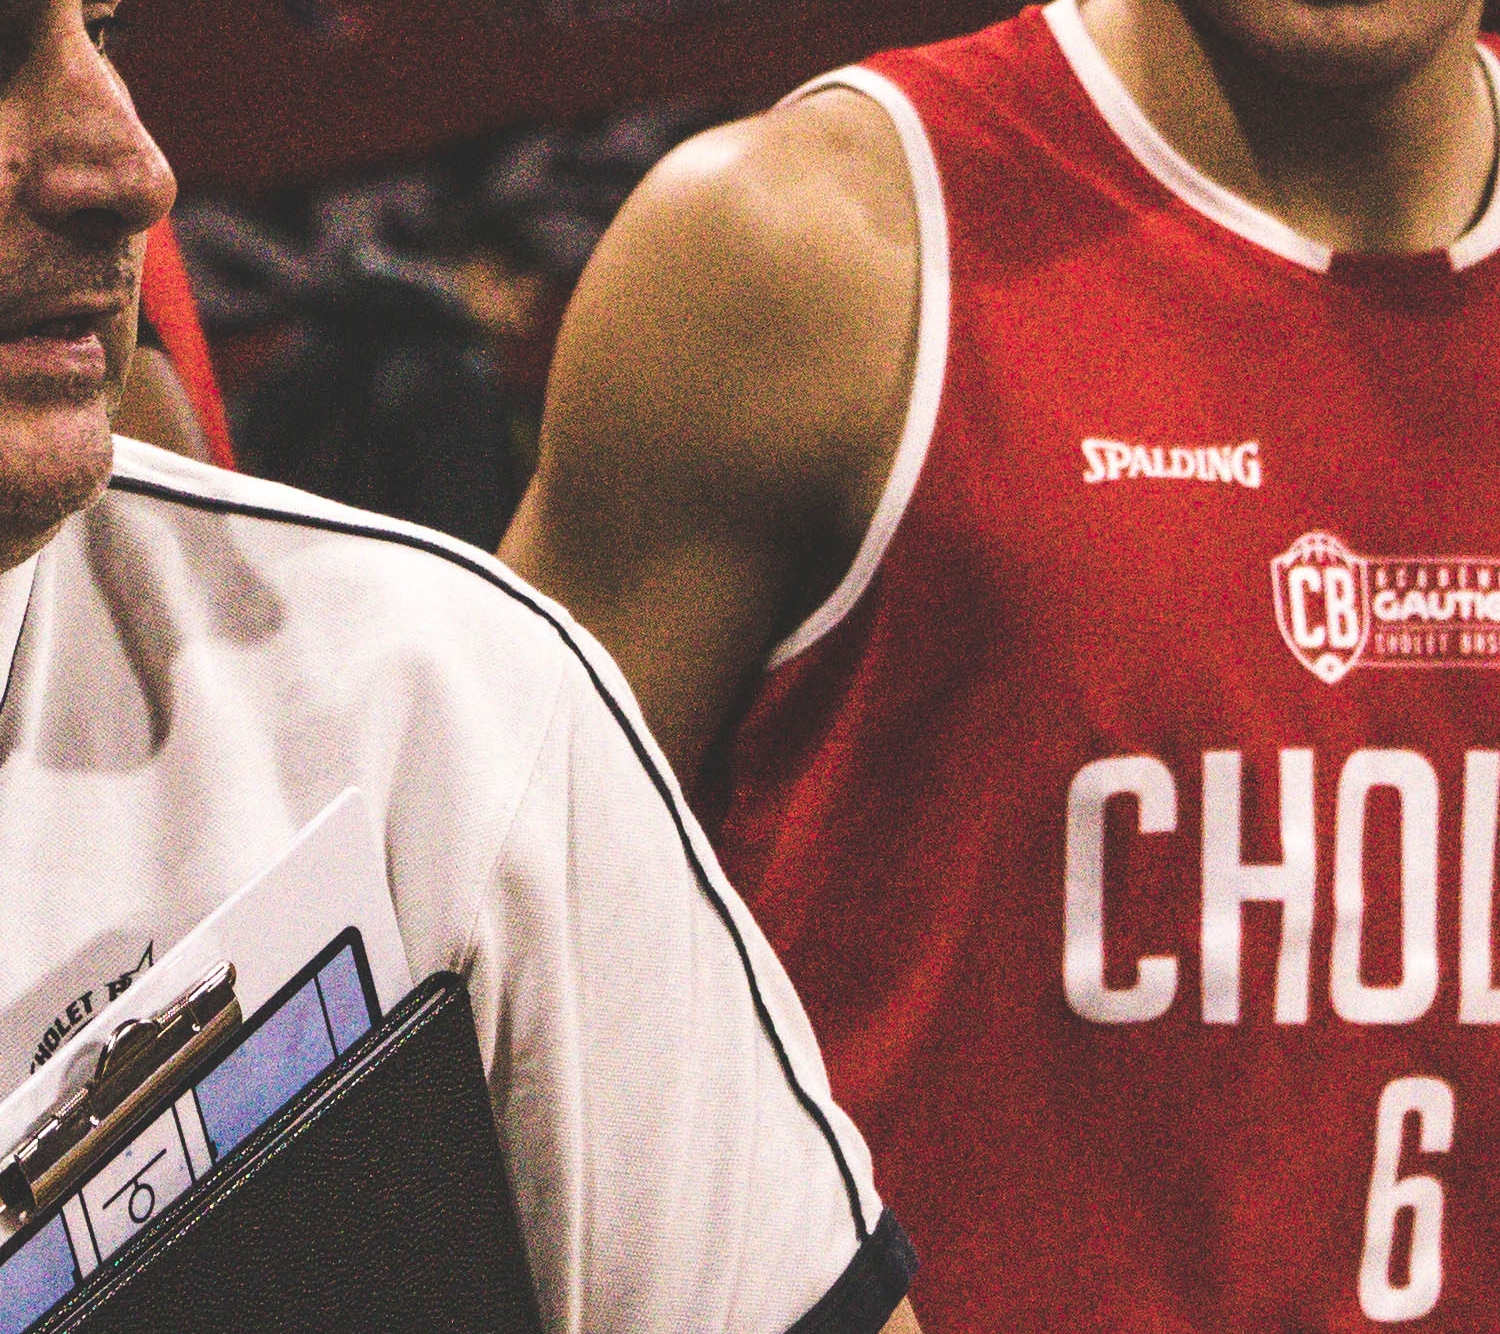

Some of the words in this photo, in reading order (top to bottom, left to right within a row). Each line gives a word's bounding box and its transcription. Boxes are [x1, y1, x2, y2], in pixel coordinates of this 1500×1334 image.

[1080, 437, 1262, 490] SPALDING
[1286, 565, 1360, 650] CB
[30, 991, 94, 1075] HOLET
[1357, 1074, 1456, 1324] 6
